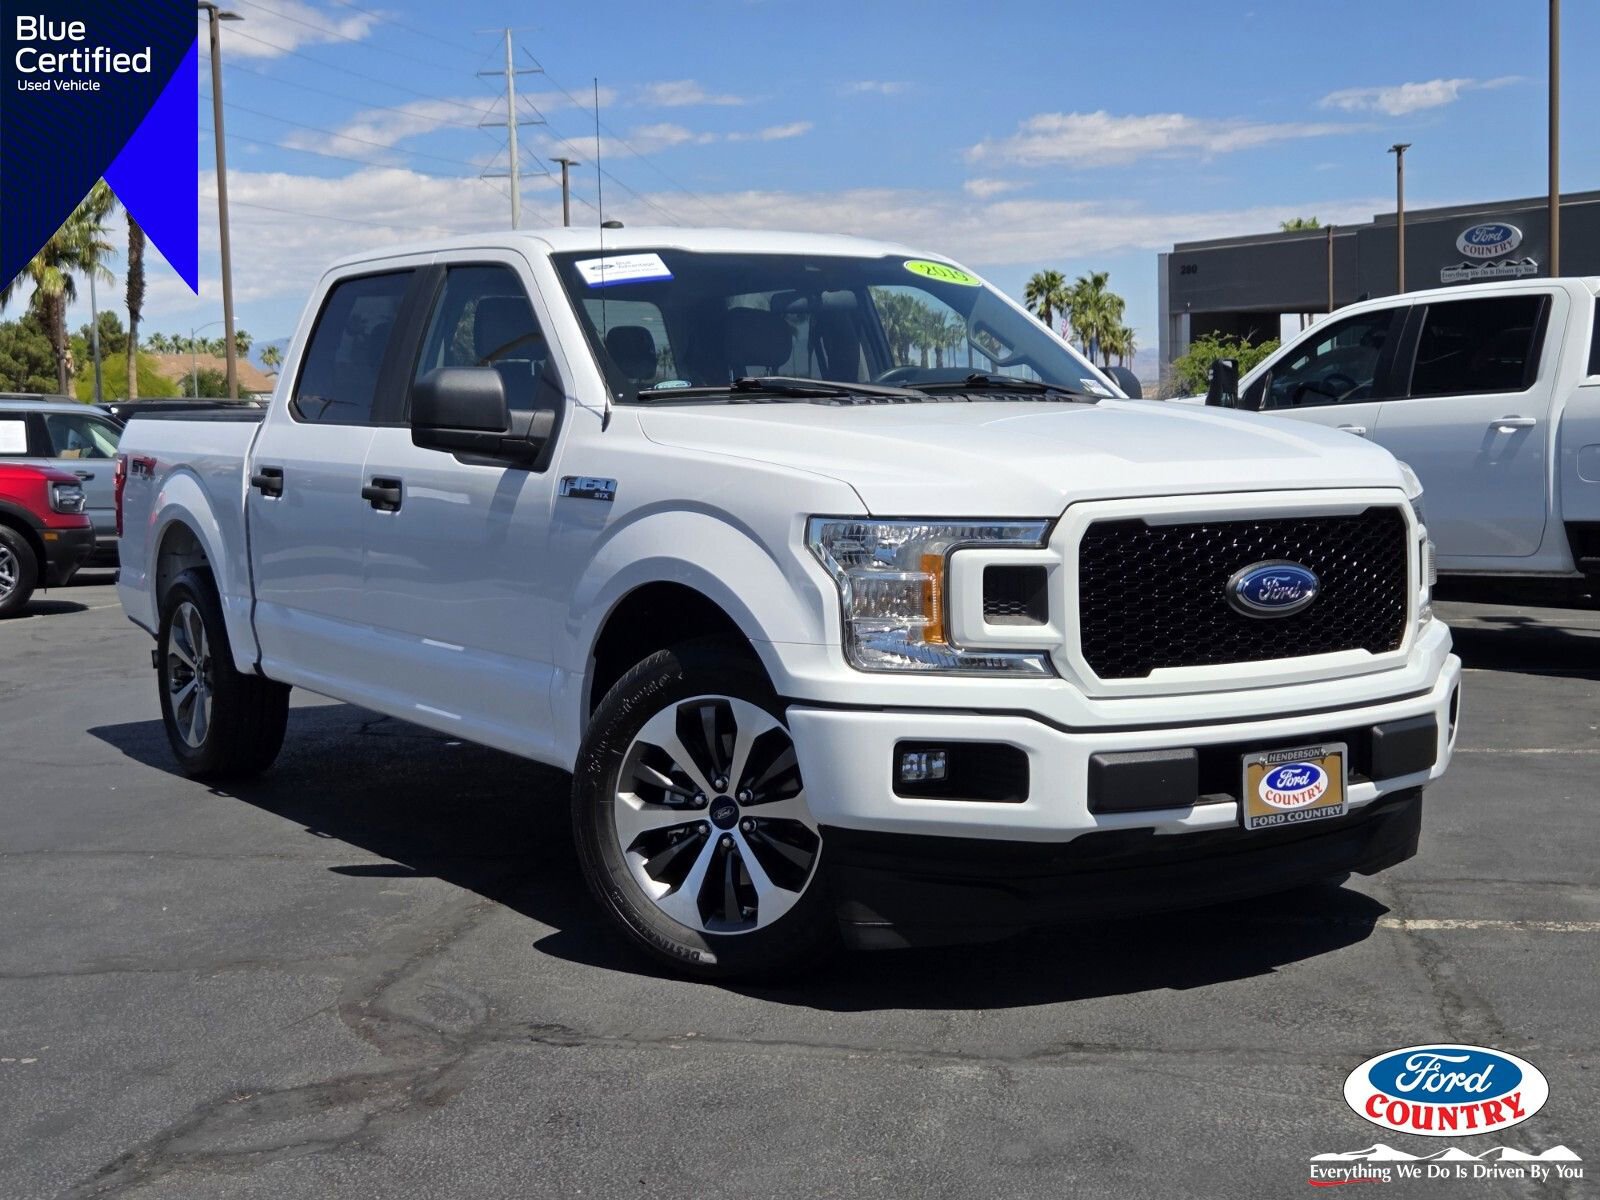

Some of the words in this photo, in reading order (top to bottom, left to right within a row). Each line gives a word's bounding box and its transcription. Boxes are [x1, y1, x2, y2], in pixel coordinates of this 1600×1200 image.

[1471, 226, 1504, 243] Ford
[1463, 240, 1514, 256] COUNTRY
[594, 492, 609, 500] STX
[1258, 576, 1302, 601] Ford
[1268, 749, 1321, 762] HENDERSON
[1276, 768, 1311, 788] Ford
[1265, 782, 1323, 805] COUNTRY
[1252, 813, 1285, 828] FORD
[1287, 805, 1342, 822] COUNTRY
